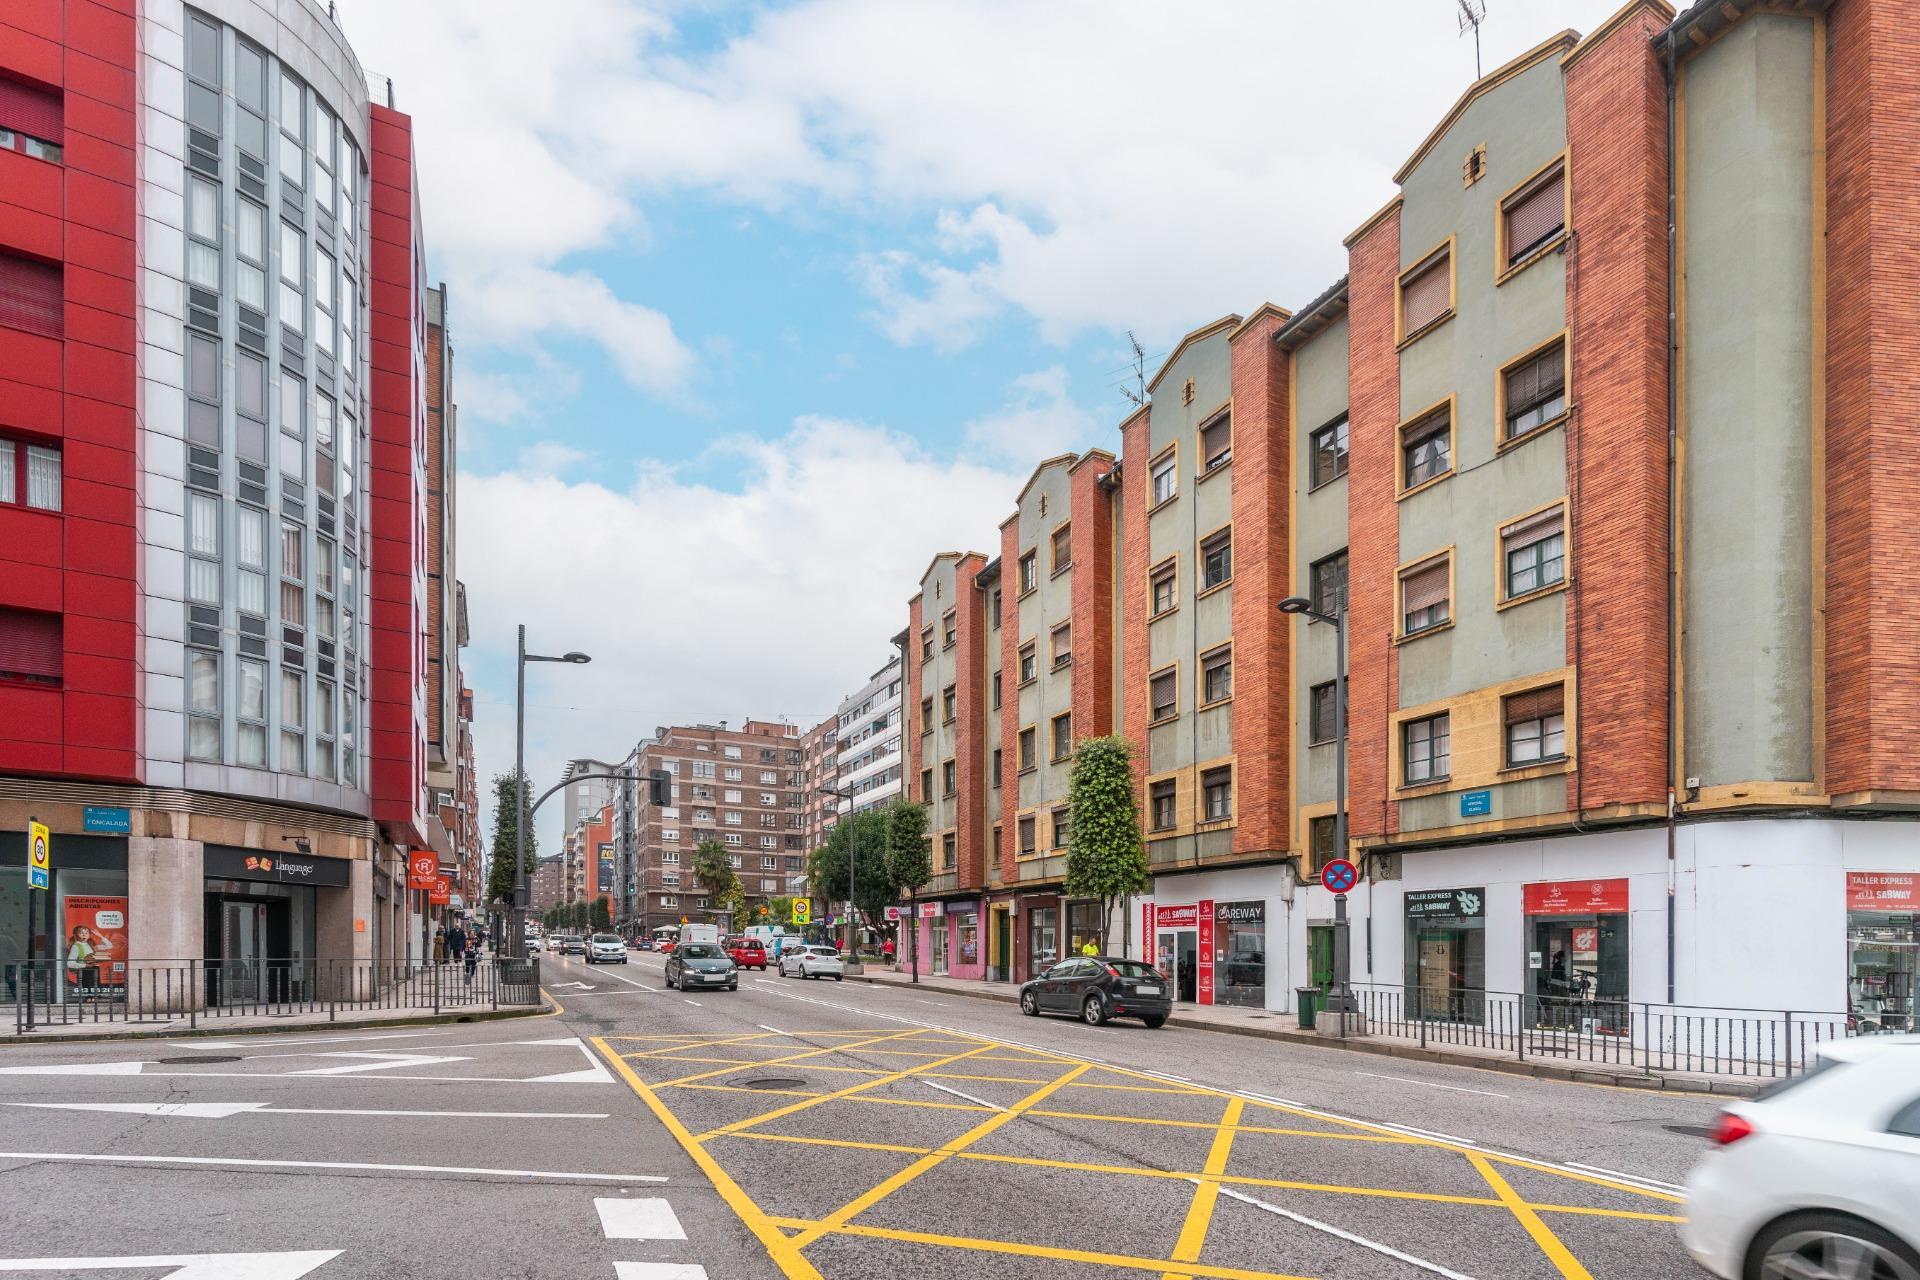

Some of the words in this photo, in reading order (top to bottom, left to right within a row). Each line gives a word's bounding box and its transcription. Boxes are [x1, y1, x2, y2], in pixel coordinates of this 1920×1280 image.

[87, 819, 128, 827] FONCALADA
[37, 845, 43, 855] 30
[1880, 877, 1913, 885] EXPRESS
[1427, 892, 1452, 900] EXPRESS
[1876, 889, 1911, 899] SABWAY
[1424, 902, 1451, 911] SABWAY
[1218, 906, 1262, 919] CAREWAY
